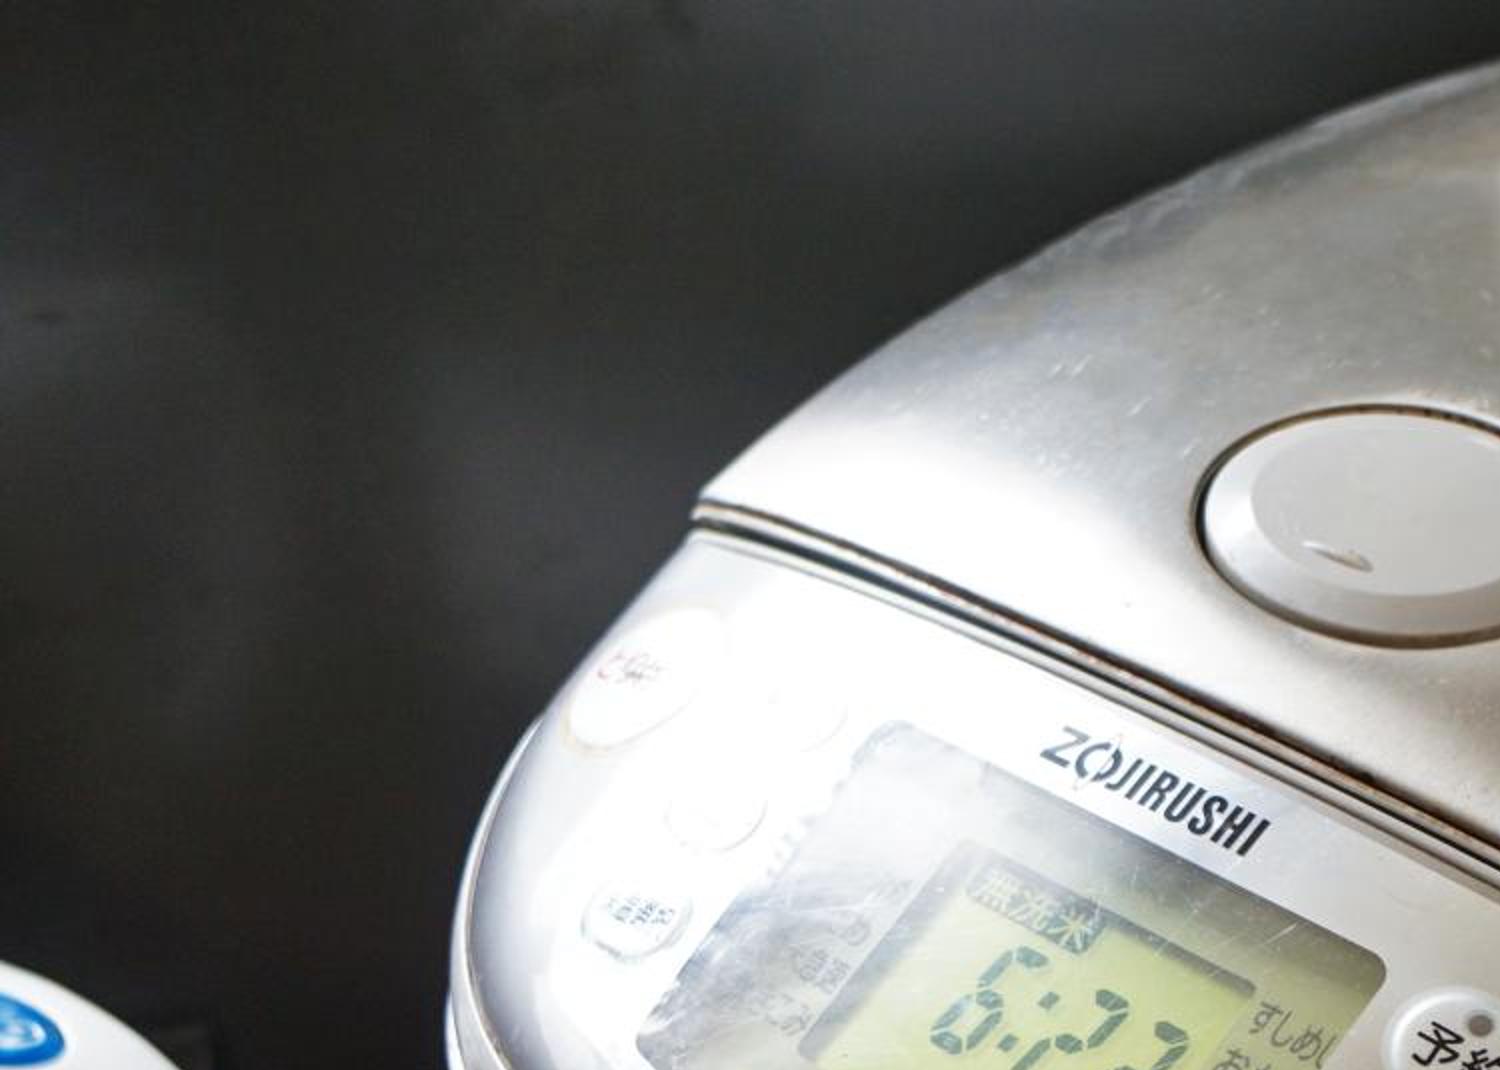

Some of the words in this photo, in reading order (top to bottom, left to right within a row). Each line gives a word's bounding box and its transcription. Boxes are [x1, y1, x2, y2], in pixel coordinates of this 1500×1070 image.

[1039, 724, 1271, 857] ZOJIRUSHI
[968, 865, 1096, 954] 無洗米
